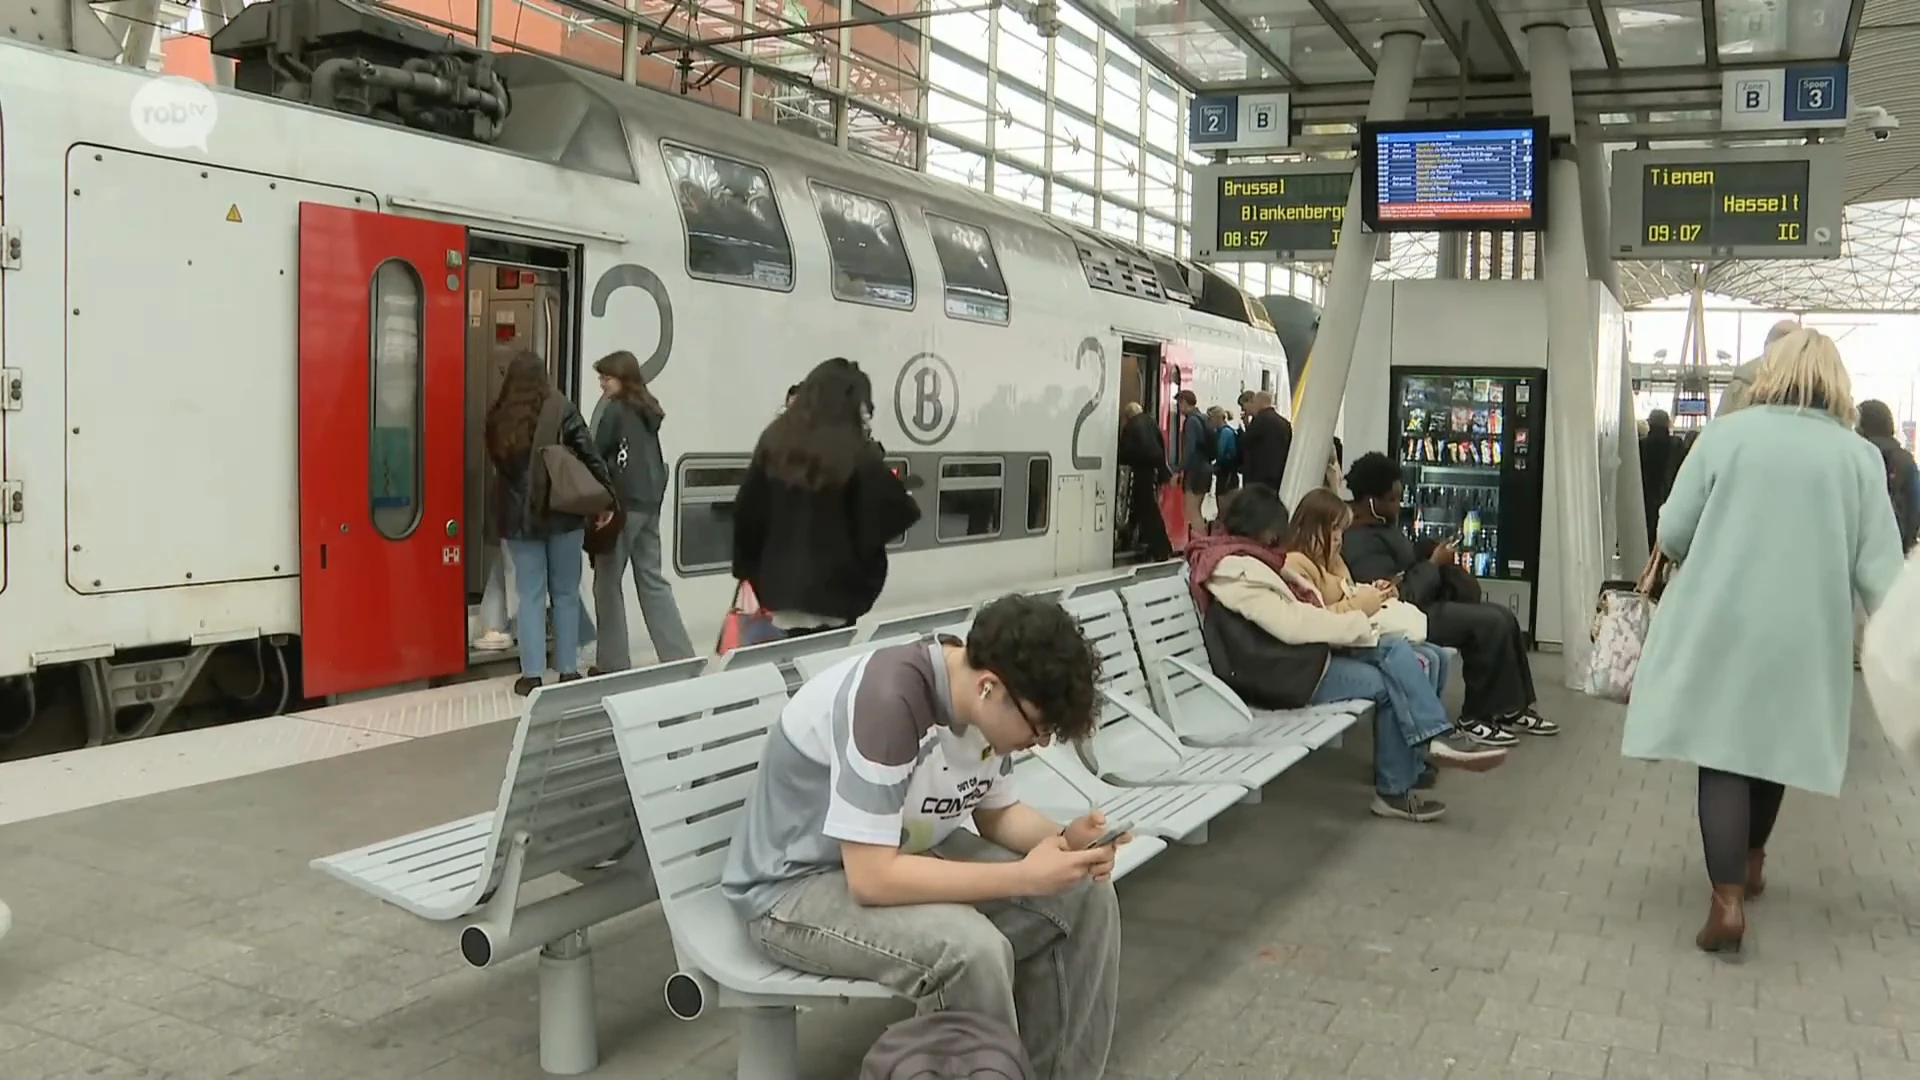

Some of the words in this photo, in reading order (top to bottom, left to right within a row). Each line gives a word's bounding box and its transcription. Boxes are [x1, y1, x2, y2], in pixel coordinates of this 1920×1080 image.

[1743, 82, 1764, 91] Zone
[1803, 80, 1830, 90] Spoor
[1746, 91, 1760, 108] B
[1808, 88, 1823, 108] 3
[1208, 115, 1219, 132] 2
[1257, 112, 1268, 128] B
[1651, 168, 1714, 185] Tienen
[1224, 179, 1285, 196] Brussel
[1723, 194, 1799, 213] Hasselt
[1223, 230, 1269, 247] 08:57
[1331, 229, 1341, 245] I
[1648, 224, 1702, 242] 09:07
[1778, 223, 1800, 241] IC
[912, 366, 943, 432] B
[1071, 336, 1106, 470] 2
